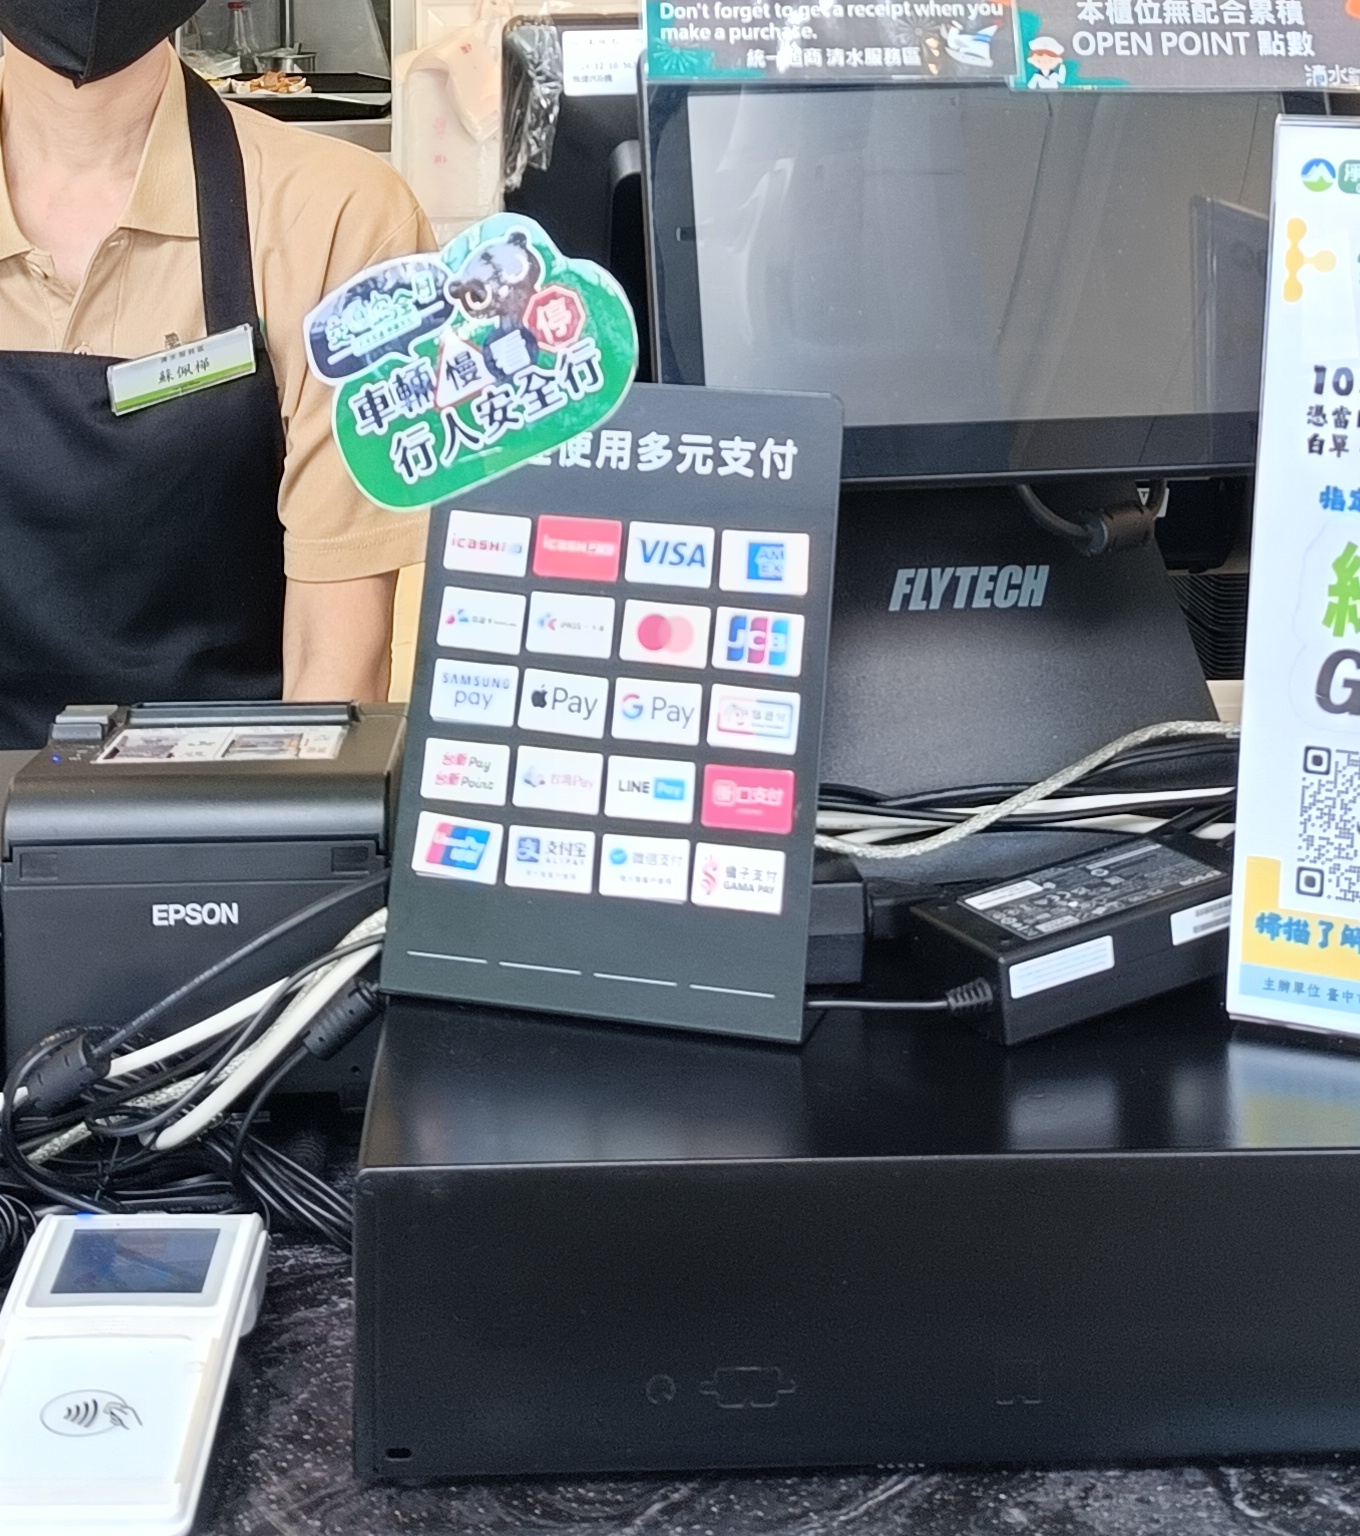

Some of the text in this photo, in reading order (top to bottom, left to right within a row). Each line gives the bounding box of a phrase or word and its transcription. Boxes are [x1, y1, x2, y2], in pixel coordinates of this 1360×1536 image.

[659, 1, 711, 20] Don't
[714, 1, 771, 24] forget
[774, 2, 795, 20] to
[832, 5, 845, 18] a
[847, 0, 912, 21] receipt
[913, 0, 965, 17] when
[967, 3, 1004, 21] you
[660, 22, 712, 42] make
[714, 27, 726, 41] a
[1071, 30, 1316, 58] OPEN POINT 點數
[536, 297, 573, 343] 停
[445, 349, 485, 392] 慢
[393, 339, 601, 481] 行人安全行
[530, 429, 798, 480] 使用多元支付
[639, 537, 707, 569] VISA
[888, 564, 1051, 612] FLYTECH
[725, 614, 789, 667] JCB
[442, 672, 511, 690] SAMSUNG
[454, 690, 494, 710] pay
[551, 686, 599, 721] Pay
[651, 696, 695, 729] Pay
[617, 779, 651, 794] LINE
[151, 901, 240, 927] EPSON
[1262, 977, 1322, 999] 主辦單位
